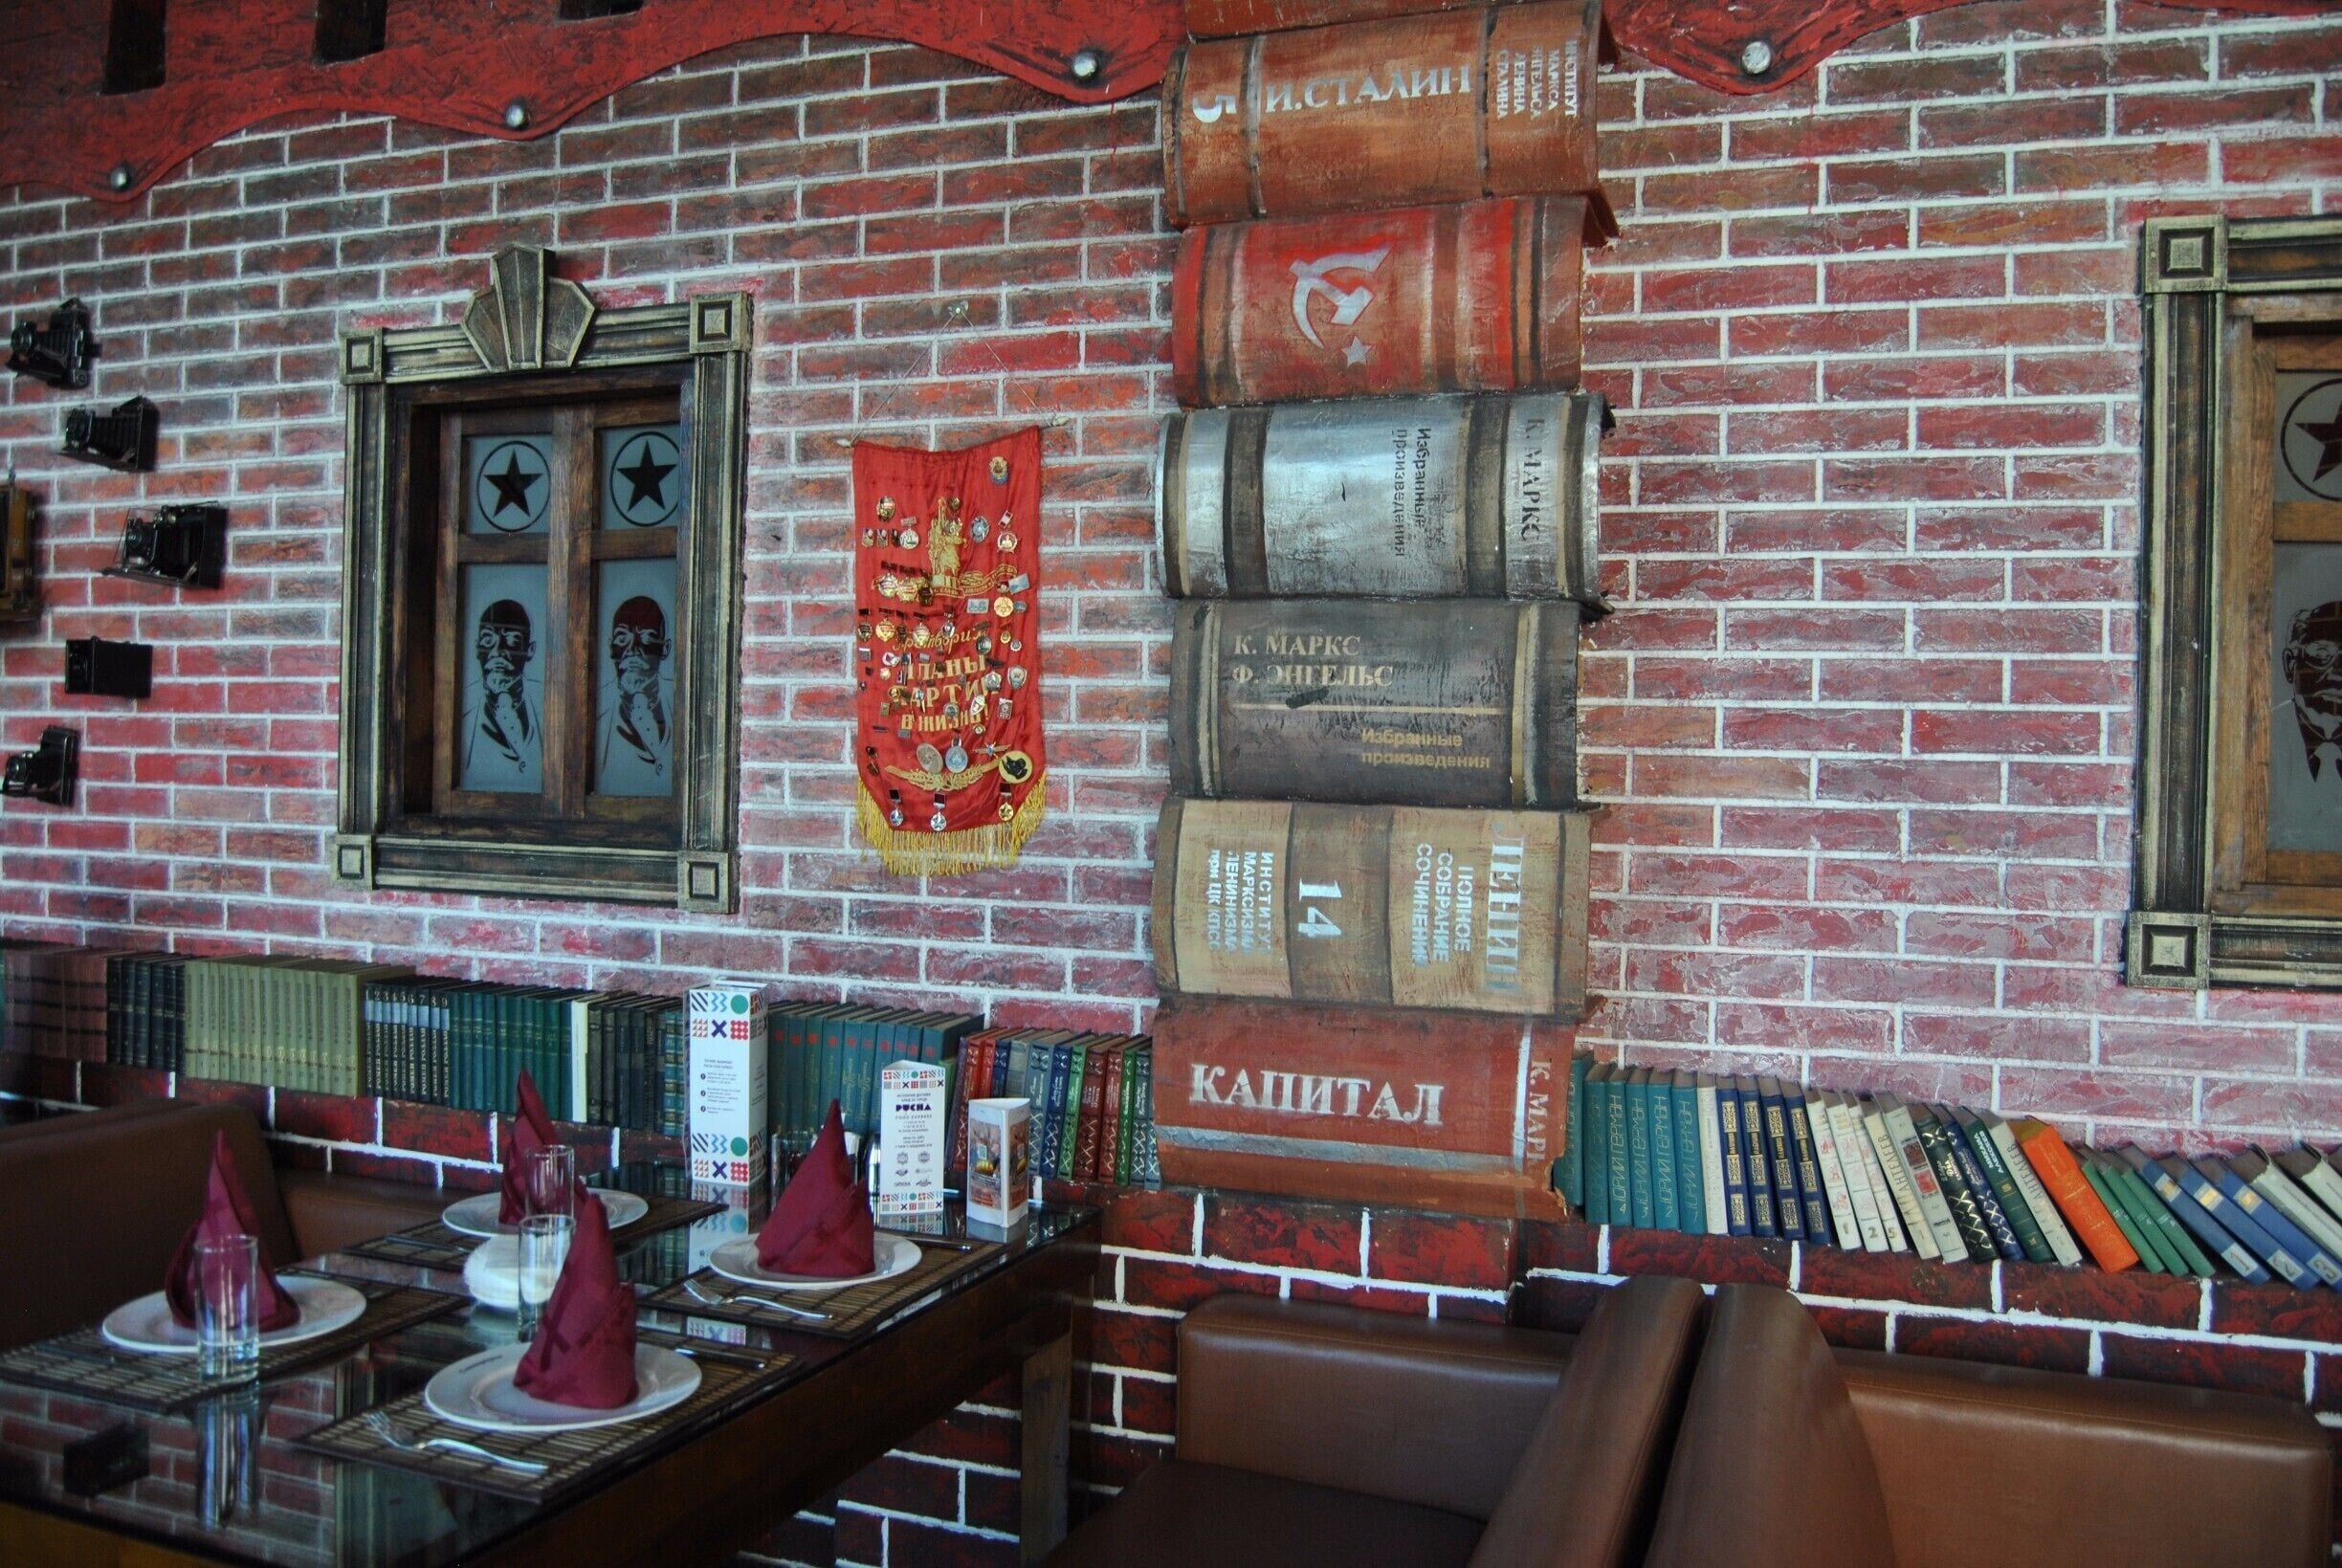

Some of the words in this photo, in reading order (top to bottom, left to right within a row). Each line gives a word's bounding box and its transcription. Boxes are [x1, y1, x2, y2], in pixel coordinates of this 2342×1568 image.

[1192, 93, 1237, 124] 5
[1496, 49, 1509, 121] СТАЛИНА
[1513, 52, 1526, 115] ЛЕНИНА
[1531, 46, 1542, 121] ЭНГЕЛЬСА
[1548, 49, 1560, 111] МАРКСА
[1565, 40, 1578, 117] ИНСТИТУТ
[1526, 418, 1545, 439] К.
[1391, 429, 1408, 557] произведения
[1413, 427, 1432, 530] Избранные
[1520, 447, 1543, 542] МАРКС
[1231, 663, 1260, 687] Ф.
[1268, 663, 1394, 688] ЭНГЕЛЬС
[1234, 635, 1258, 655] К.
[1265, 633, 1362, 656] МАРКС
[1361, 727, 1464, 748] Избранные
[1362, 750, 1491, 770] произведения
[1205, 882, 1221, 905] ЦК
[1208, 850, 1221, 878] при
[1207, 908, 1221, 951] КПСС
[1224, 850, 1239, 952] ЛЕНИНИЗМА
[1241, 851, 1257, 954] МАРКСИЗМА
[1258, 851, 1274, 954] ИНСТИТУТ
[1297, 877, 1342, 939] 14
[1433, 851, 1453, 962] СОБРАНИЕ
[1453, 866, 1474, 952] ПОЛНОЕ
[1486, 822, 1525, 991] ЛЕНИН
[1190, 1063, 1445, 1127] КАПИТАЛ
[1530, 1060, 1552, 1086] К.
[1974, 1133, 1994, 1168] МИХАИЛ
[1978, 1130, 2004, 1174] АЛЕКСЕЕВ
[1868, 1226, 1878, 1238] 2
[1888, 1226, 1897, 1238] 5
[2314, 1260, 2337, 1280] 3
